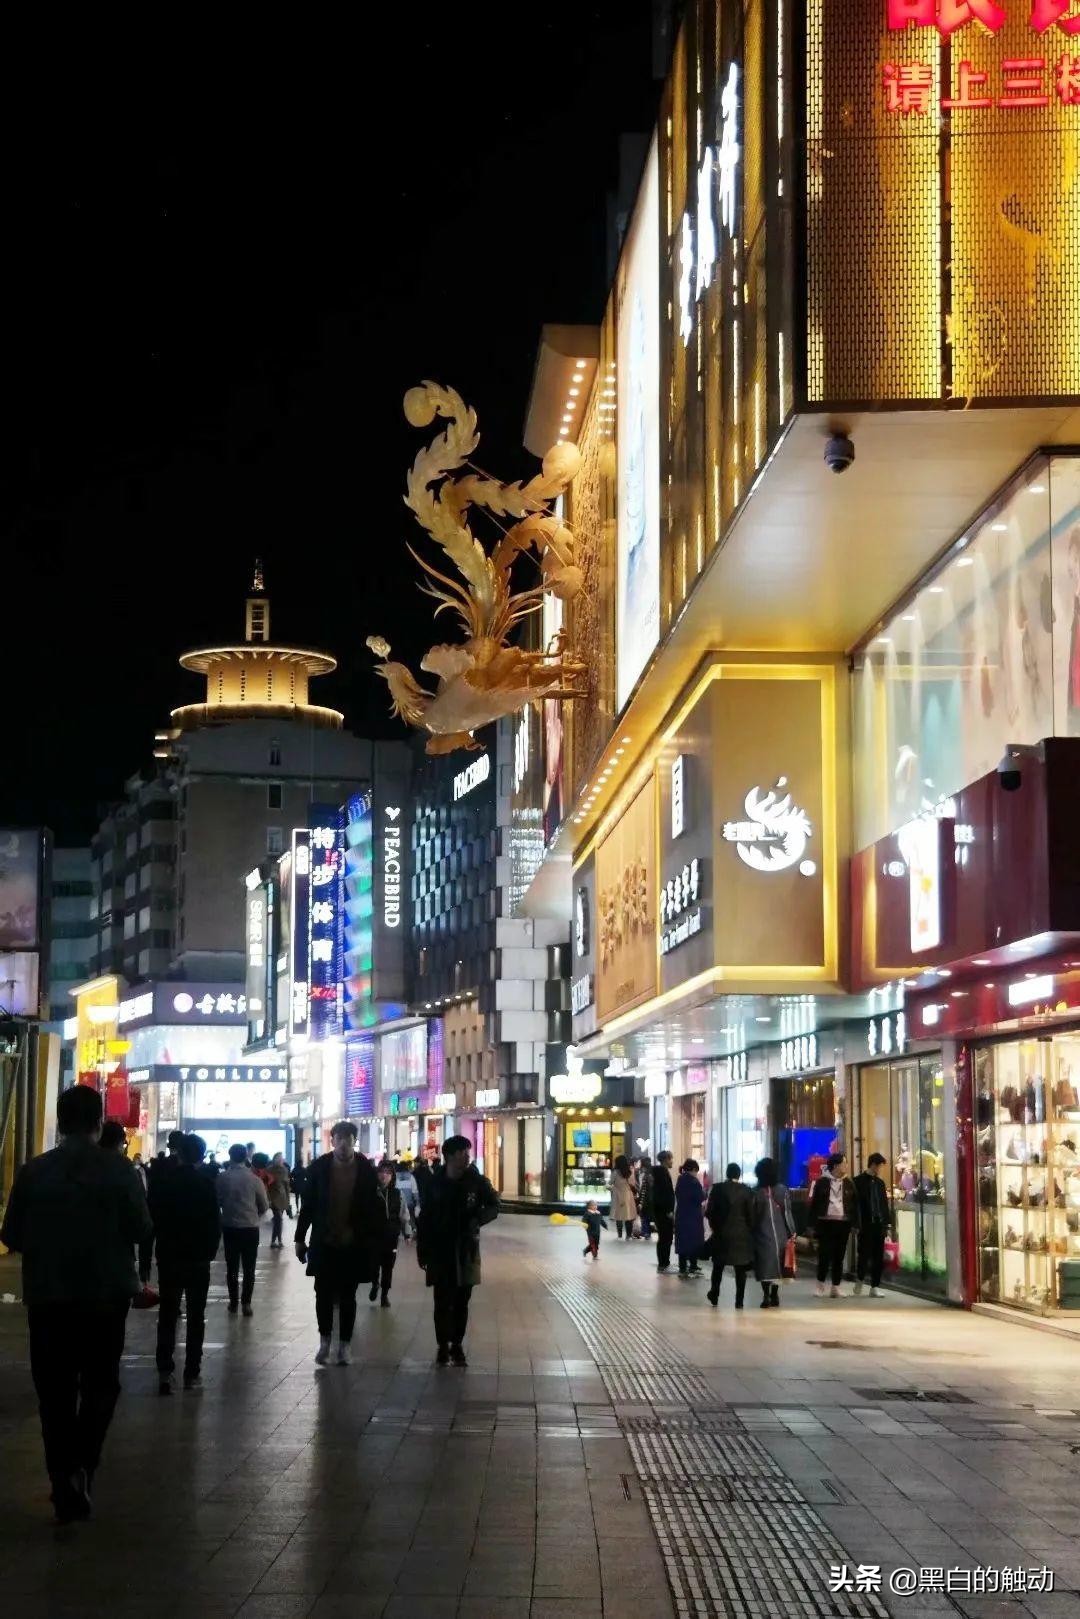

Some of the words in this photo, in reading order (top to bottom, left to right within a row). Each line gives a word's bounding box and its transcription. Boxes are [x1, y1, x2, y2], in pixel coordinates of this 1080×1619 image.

[454, 754, 490, 800] PEACEBIRD
[312, 827, 335, 961] 特步体育
[385, 827, 400, 927] PEACEBIRD
[180, 1068, 287, 1080] TONLION
